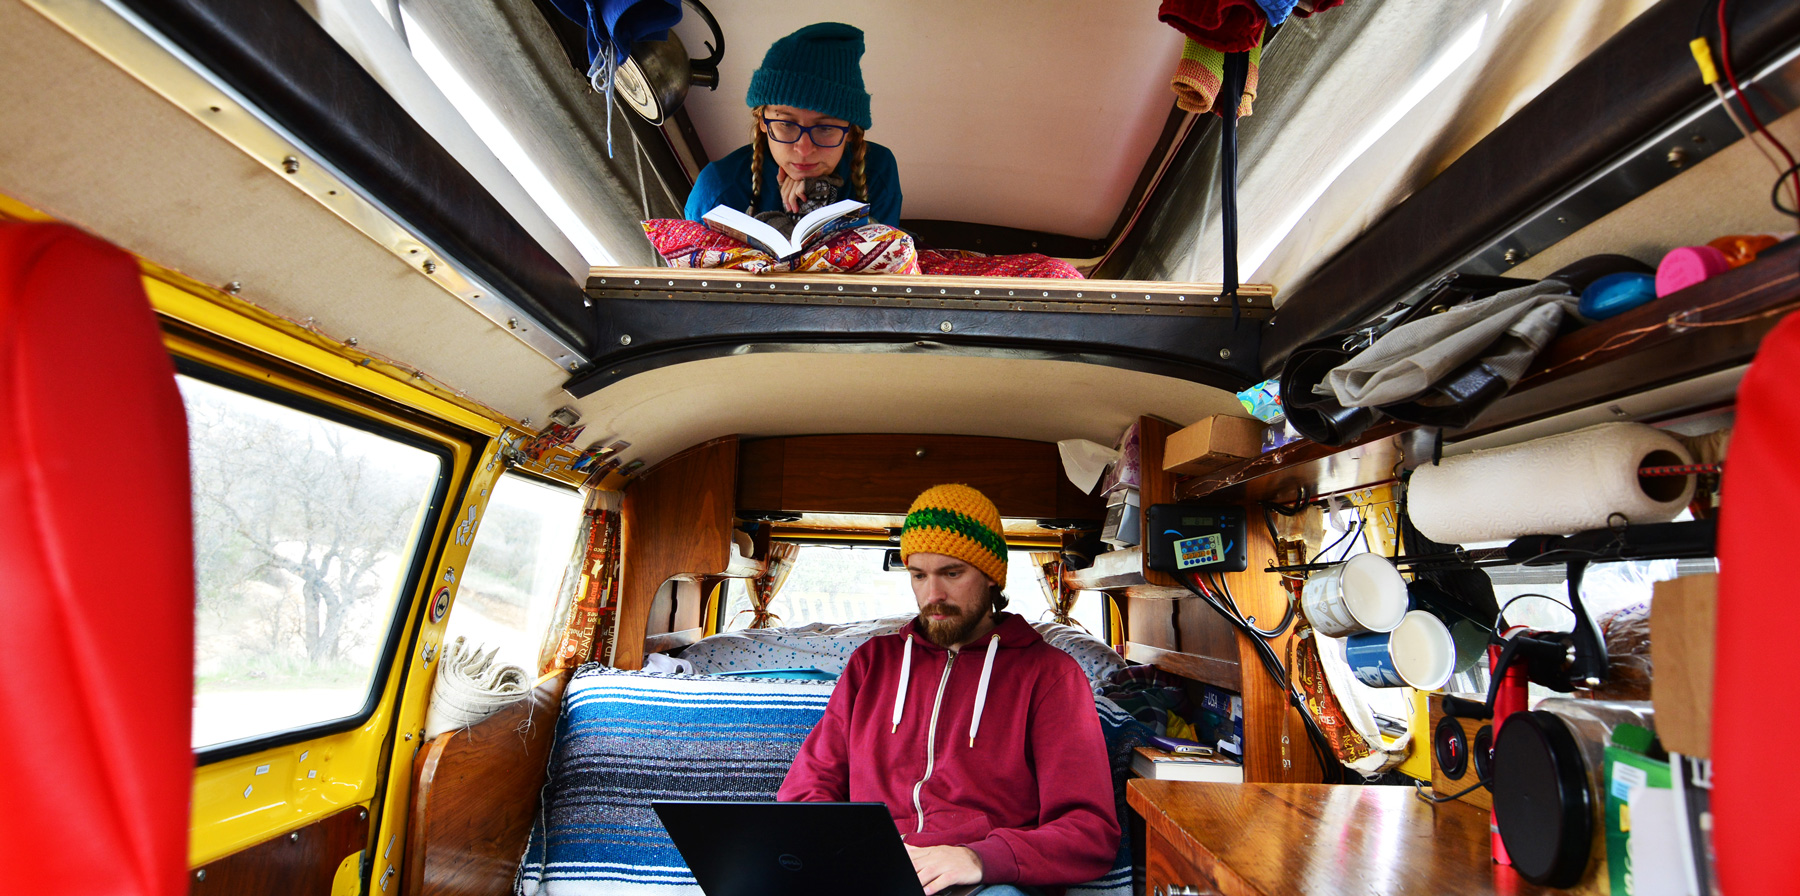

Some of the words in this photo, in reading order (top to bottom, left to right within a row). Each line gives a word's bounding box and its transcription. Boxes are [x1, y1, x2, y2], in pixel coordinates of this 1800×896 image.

[588, 581, 599, 604] Road
[576, 625, 595, 659] TRAVEL
[1207, 692, 1218, 709] USA
